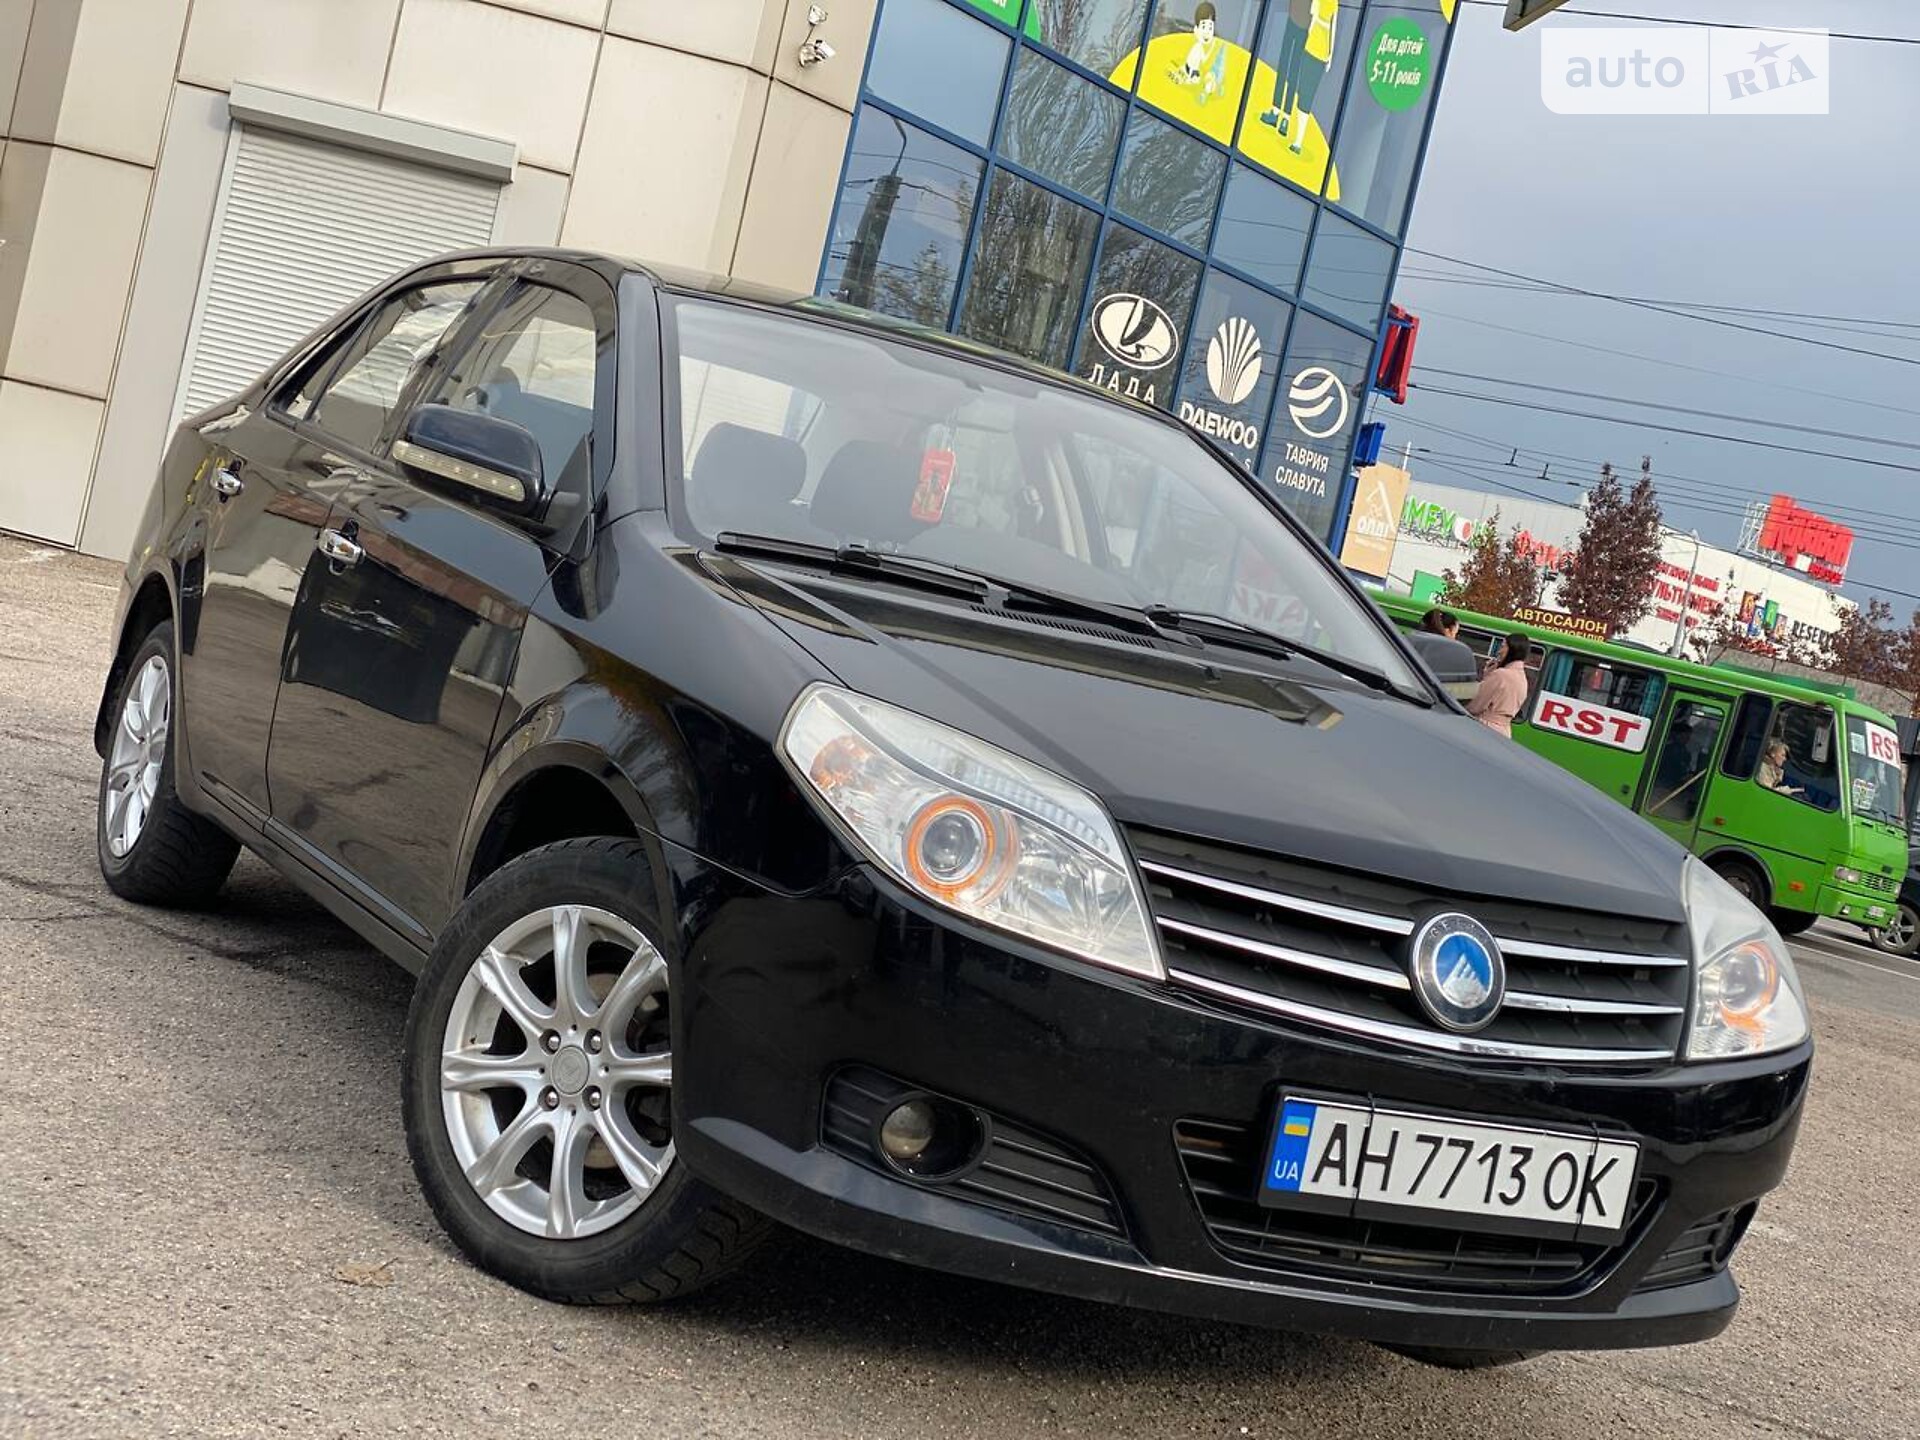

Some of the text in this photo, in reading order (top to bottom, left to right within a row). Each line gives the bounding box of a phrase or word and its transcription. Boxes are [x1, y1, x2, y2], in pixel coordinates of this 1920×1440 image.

[1377, 33, 1424, 56] Для дітей
[1370, 59, 1421, 88] 5-11 років
[1089, 363, 1156, 404] ЛАДА
[1179, 401, 1258, 449] DAEWOO
[1285, 443, 1329, 473] ТАВРИЯ
[1275, 466, 1326, 498] СЛАВУТА
[1513, 607, 1608, 634] АВТОСАЛОН
[1540, 699, 1641, 743] RST
[1274, 1159, 1299, 1181] UA
